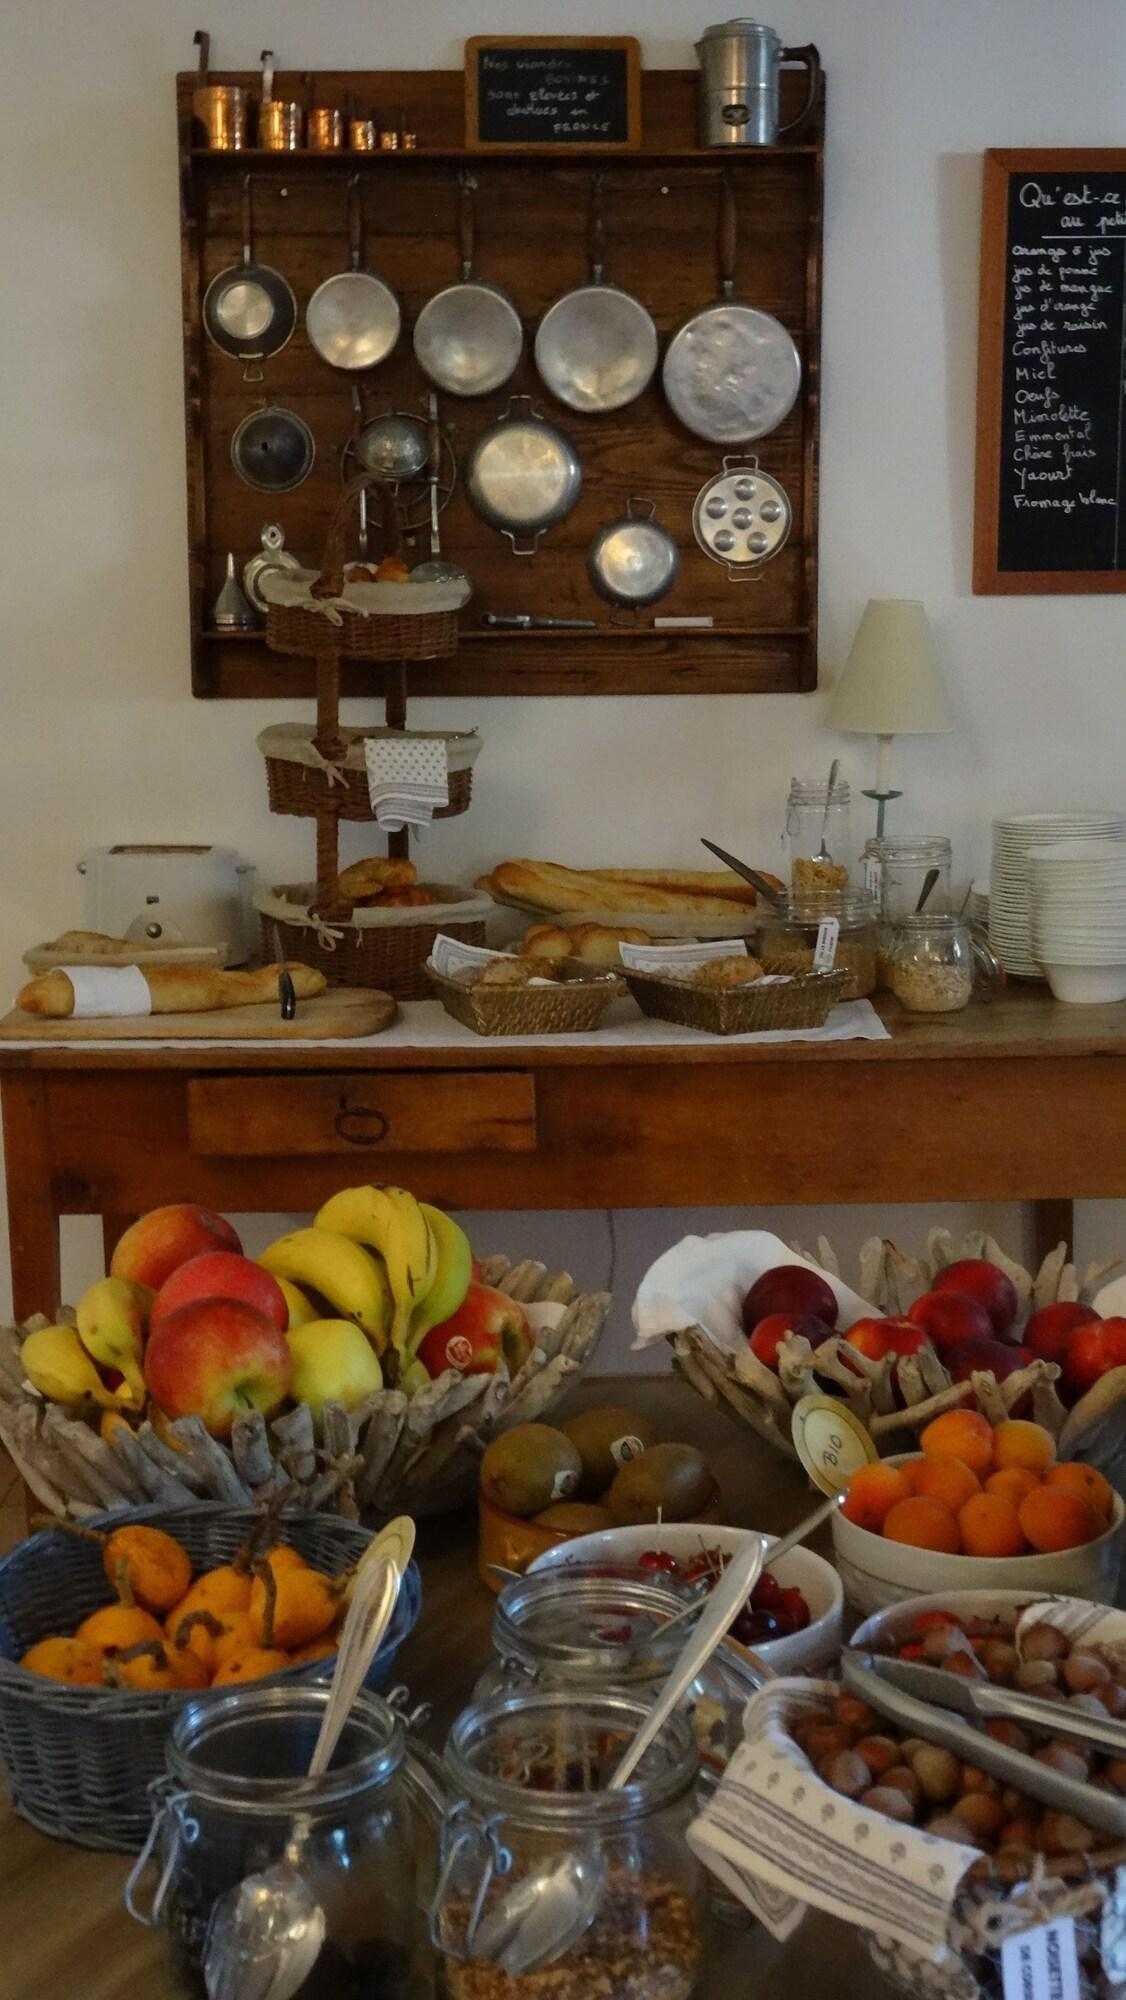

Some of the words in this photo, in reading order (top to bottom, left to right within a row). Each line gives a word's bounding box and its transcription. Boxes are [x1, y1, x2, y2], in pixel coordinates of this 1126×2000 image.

[553, 122, 611, 133] FRANCE
[1019, 182, 1121, 208] Qu'est-ce
[1060, 215, 1085, 228] au
[1088, 245, 1112, 265] jus
[1011, 265, 1033, 283] jus
[1037, 264, 1053, 276] de
[1058, 266, 1099, 281] pomme
[1039, 280, 1054, 292] de
[1059, 283, 1113, 302] mangue
[1013, 303, 1035, 320] jus
[1039, 298, 1097, 317] d'orange
[1015, 321, 1037, 338] jus
[1039, 319, 1056, 331] de
[1062, 319, 1108, 331] raisin
[1012, 340, 1087, 365] Confitures
[1015, 361, 1057, 381] Miel
[1015, 386, 1060, 408] Oeufs
[1013, 403, 1090, 425] Mimolette
[1015, 422, 1093, 442] Emmental
[1062, 443, 1097, 464] frais
[1013, 464, 1073, 490] Yaourt
[1013, 494, 1076, 514] Fromage
[1078, 489, 1117, 505] blanc
[822, 1434, 843, 1467] BIO
